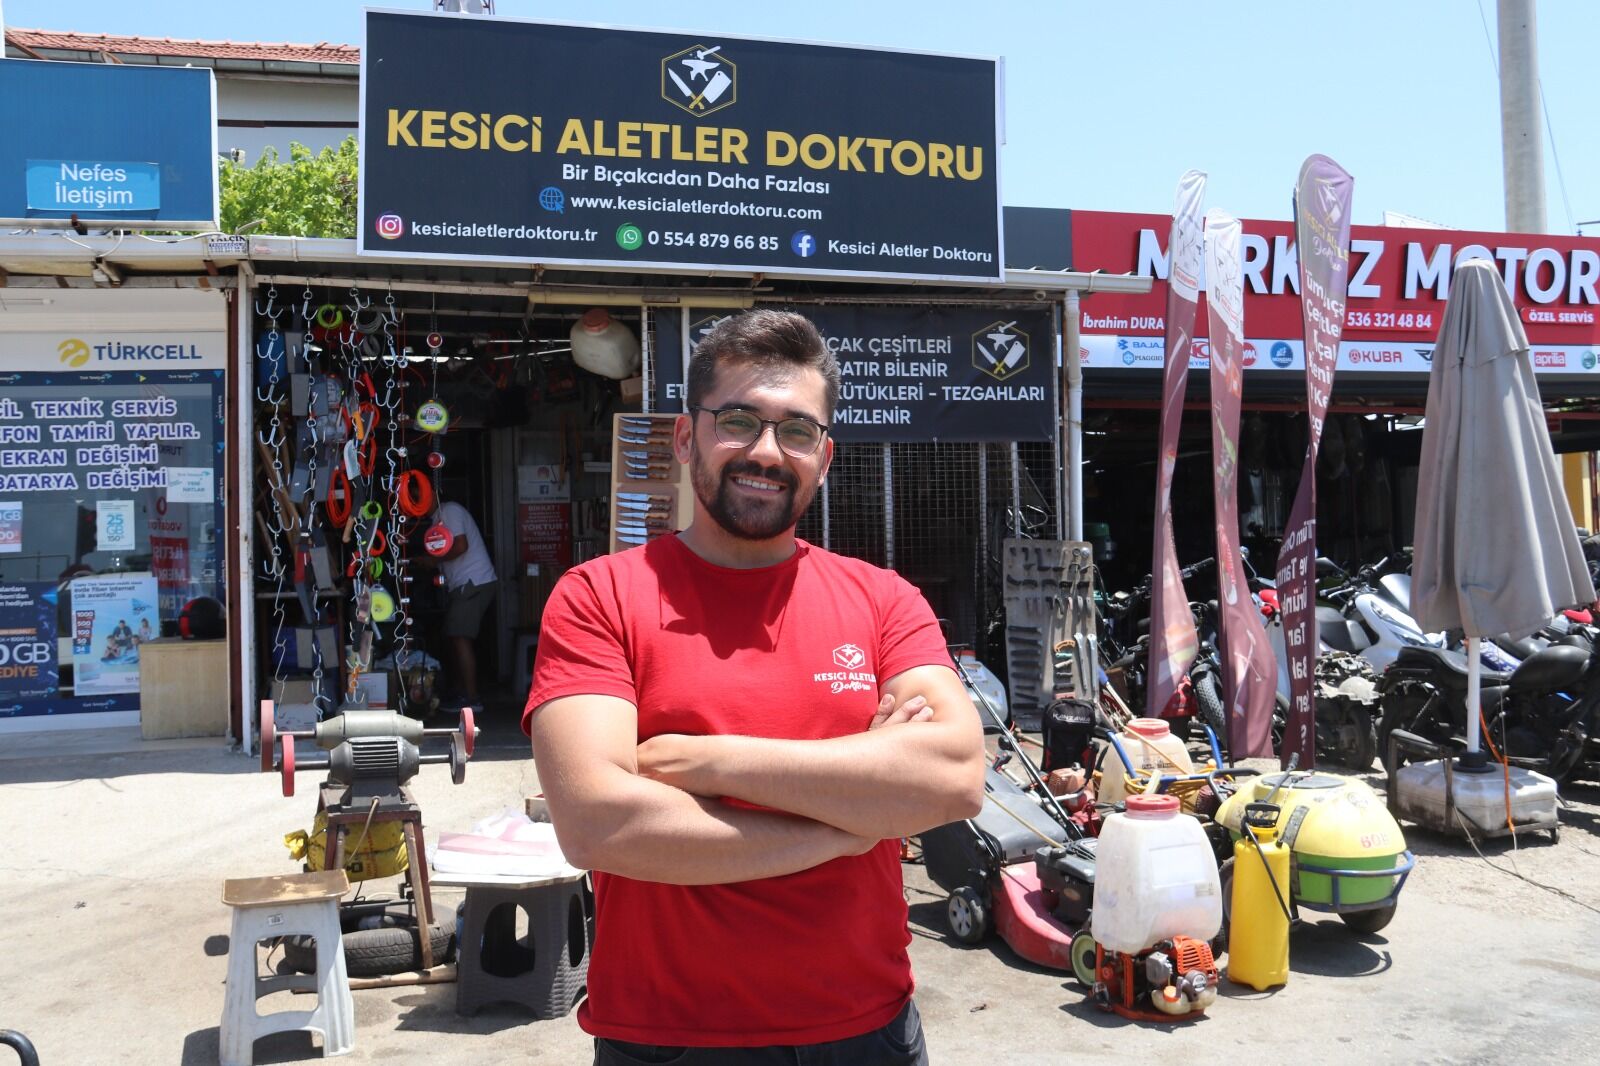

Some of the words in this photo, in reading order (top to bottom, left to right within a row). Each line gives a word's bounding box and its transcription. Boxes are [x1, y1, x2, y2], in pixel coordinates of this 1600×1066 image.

[556, 118, 749, 165] ALETLER
[766, 130, 983, 181] DOKTORU
[61, 163, 127, 182] Nefes
[562, 163, 589, 181] Bir
[594, 165, 702, 188] Bıçakcıdan
[707, 171, 759, 190] Daha
[765, 174, 830, 194] Fazlası
[55, 182, 133, 208] İletişim
[570, 193, 823, 220] www.kesicialetlerdoktoru.com
[411, 221, 598, 243] kesicialetlerdoktoru.tr
[647, 231, 659, 245] 0
[664, 231, 695, 246] 554
[699, 233, 730, 248] 879
[733, 234, 755, 250] 66
[758, 235, 779, 251] 85
[828, 239, 876, 255] Kesici
[879, 242, 929, 258] Aletler
[932, 246, 993, 263] Doktoru
[1138, 228, 1385, 298] MRKZ
[1405, 241, 1600, 305] MTOR
[1083, 312, 1128, 330] İbrahim
[1346, 311, 1371, 327] 536
[1373, 312, 1395, 328] 321
[1397, 313, 1413, 328] 48
[1415, 314, 1432, 328] 84
[1528, 309, 1556, 322] ÖZEL
[1558, 311, 1594, 323] SERVİS
[823, 336, 864, 356] ÇAK
[868, 334, 952, 357] ÇEŞİTLERİ
[884, 358, 948, 378] BİLENİR
[1362, 351, 1403, 363] KUBA
[942, 386, 1045, 401] TEZGAHLARI
[0, 399, 21, 418] İL
[34, 398, 102, 418] TEKNİK
[114, 396, 176, 416] SERVİS
[52, 422, 113, 441] TAMİRİ
[125, 424, 199, 439] YAPILIR.
[2, 450, 65, 466] EKRAN
[78, 445, 157, 468] DEĞİŞİMİ
[88, 467, 167, 491] DEĞİŞİMİ
[13, 642, 51, 664] GB
